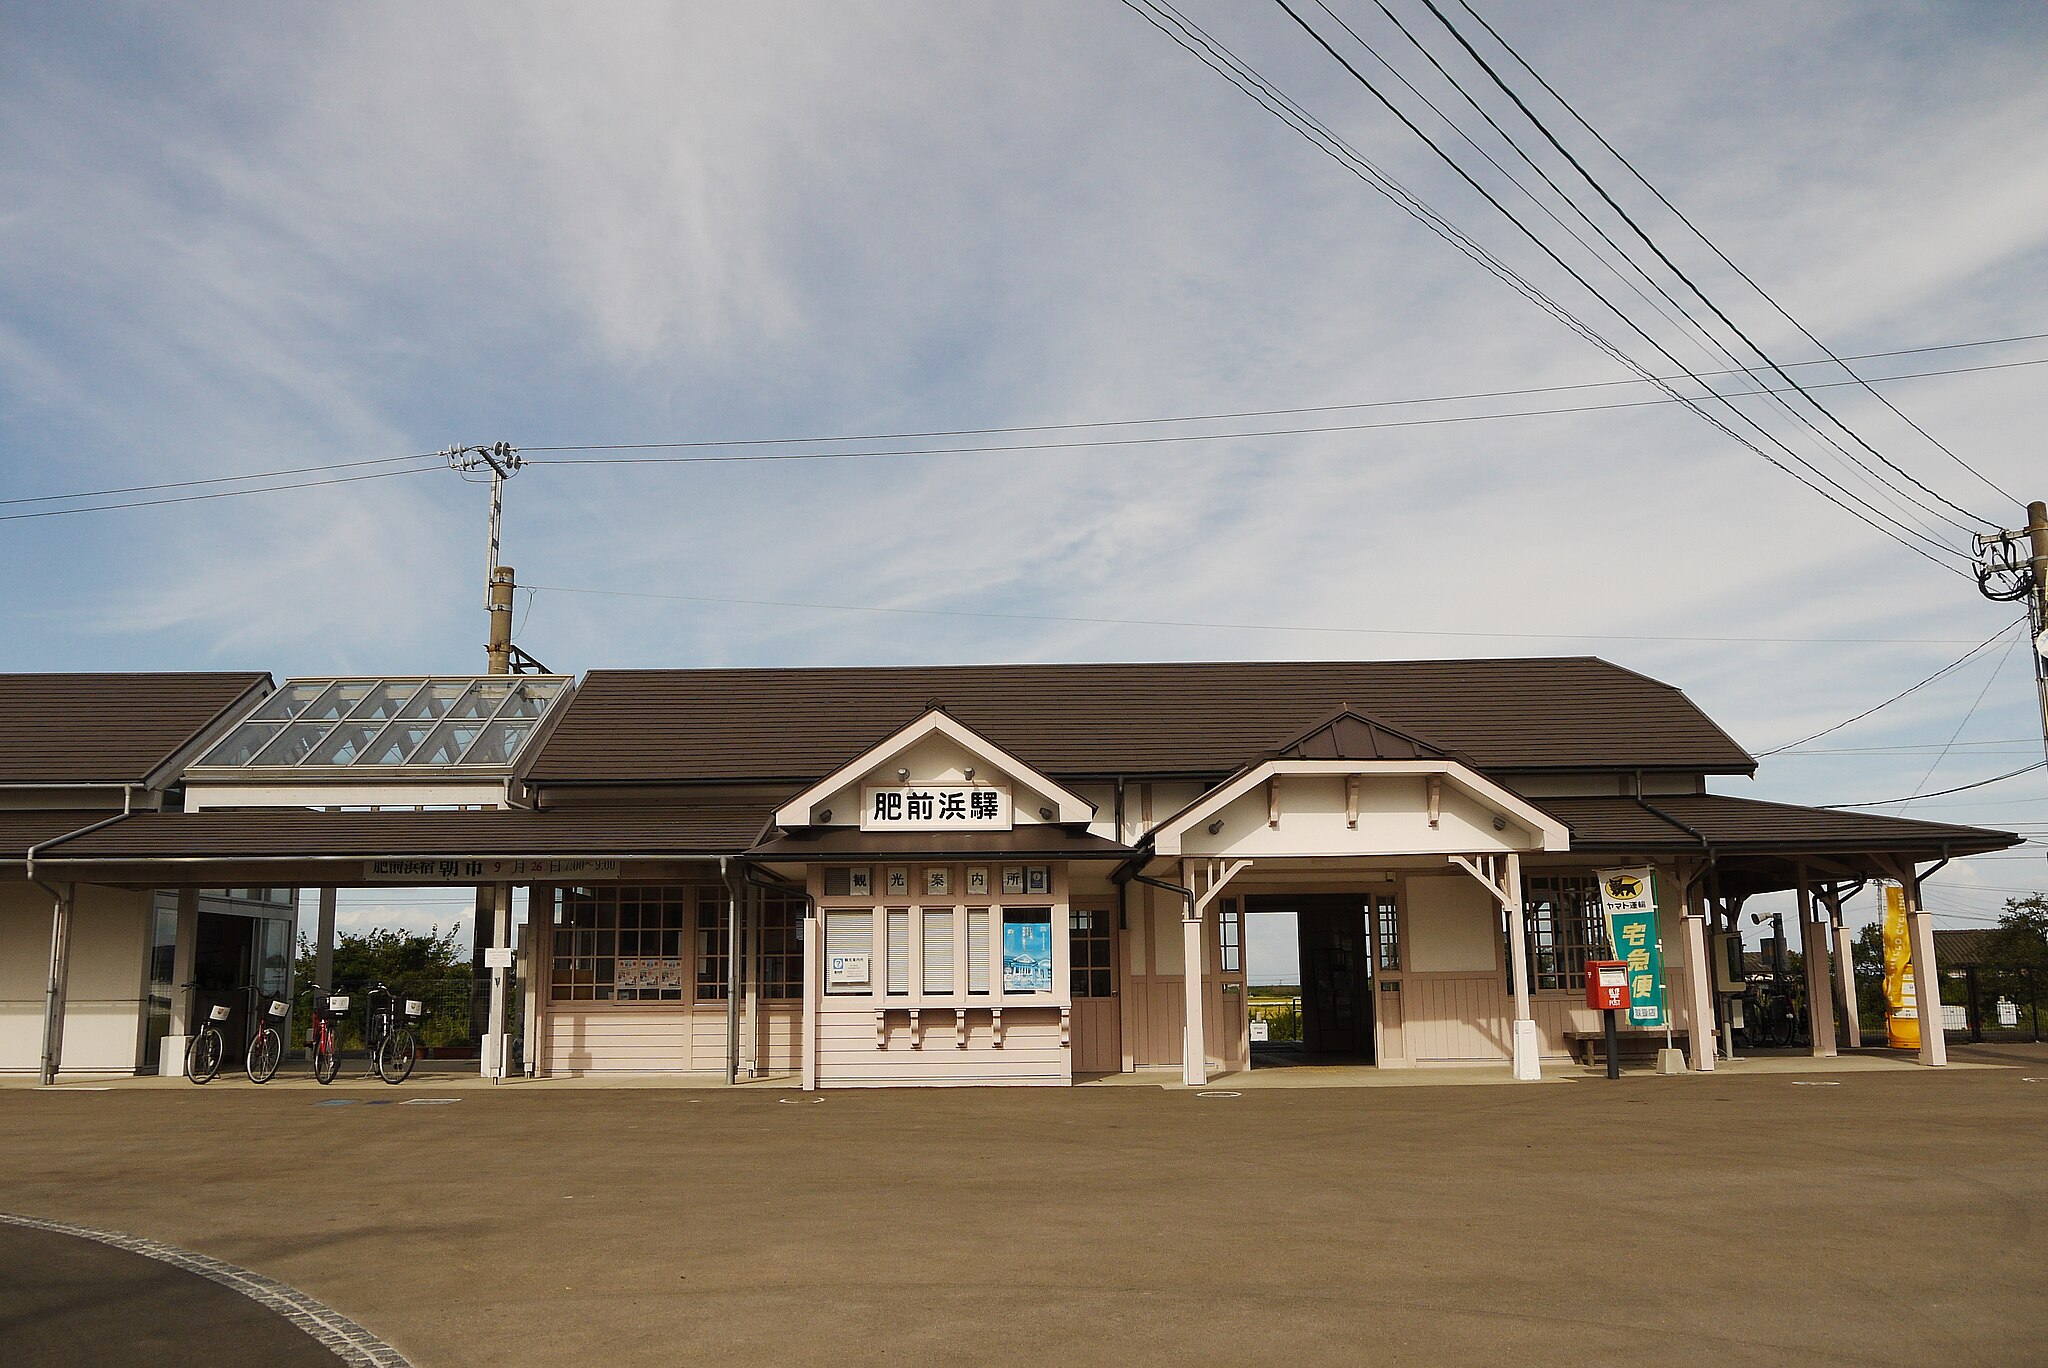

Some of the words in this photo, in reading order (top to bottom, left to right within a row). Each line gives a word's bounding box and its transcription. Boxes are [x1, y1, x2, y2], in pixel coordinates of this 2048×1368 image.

[874, 792, 998, 820] 肥前浜驛
[1607, 901, 1647, 910] ヤマト運輸
[1890, 938, 1902, 970] HELLO
[1896, 893, 1906, 935] CYCLING
[1622, 922, 1653, 998] 宅急便
